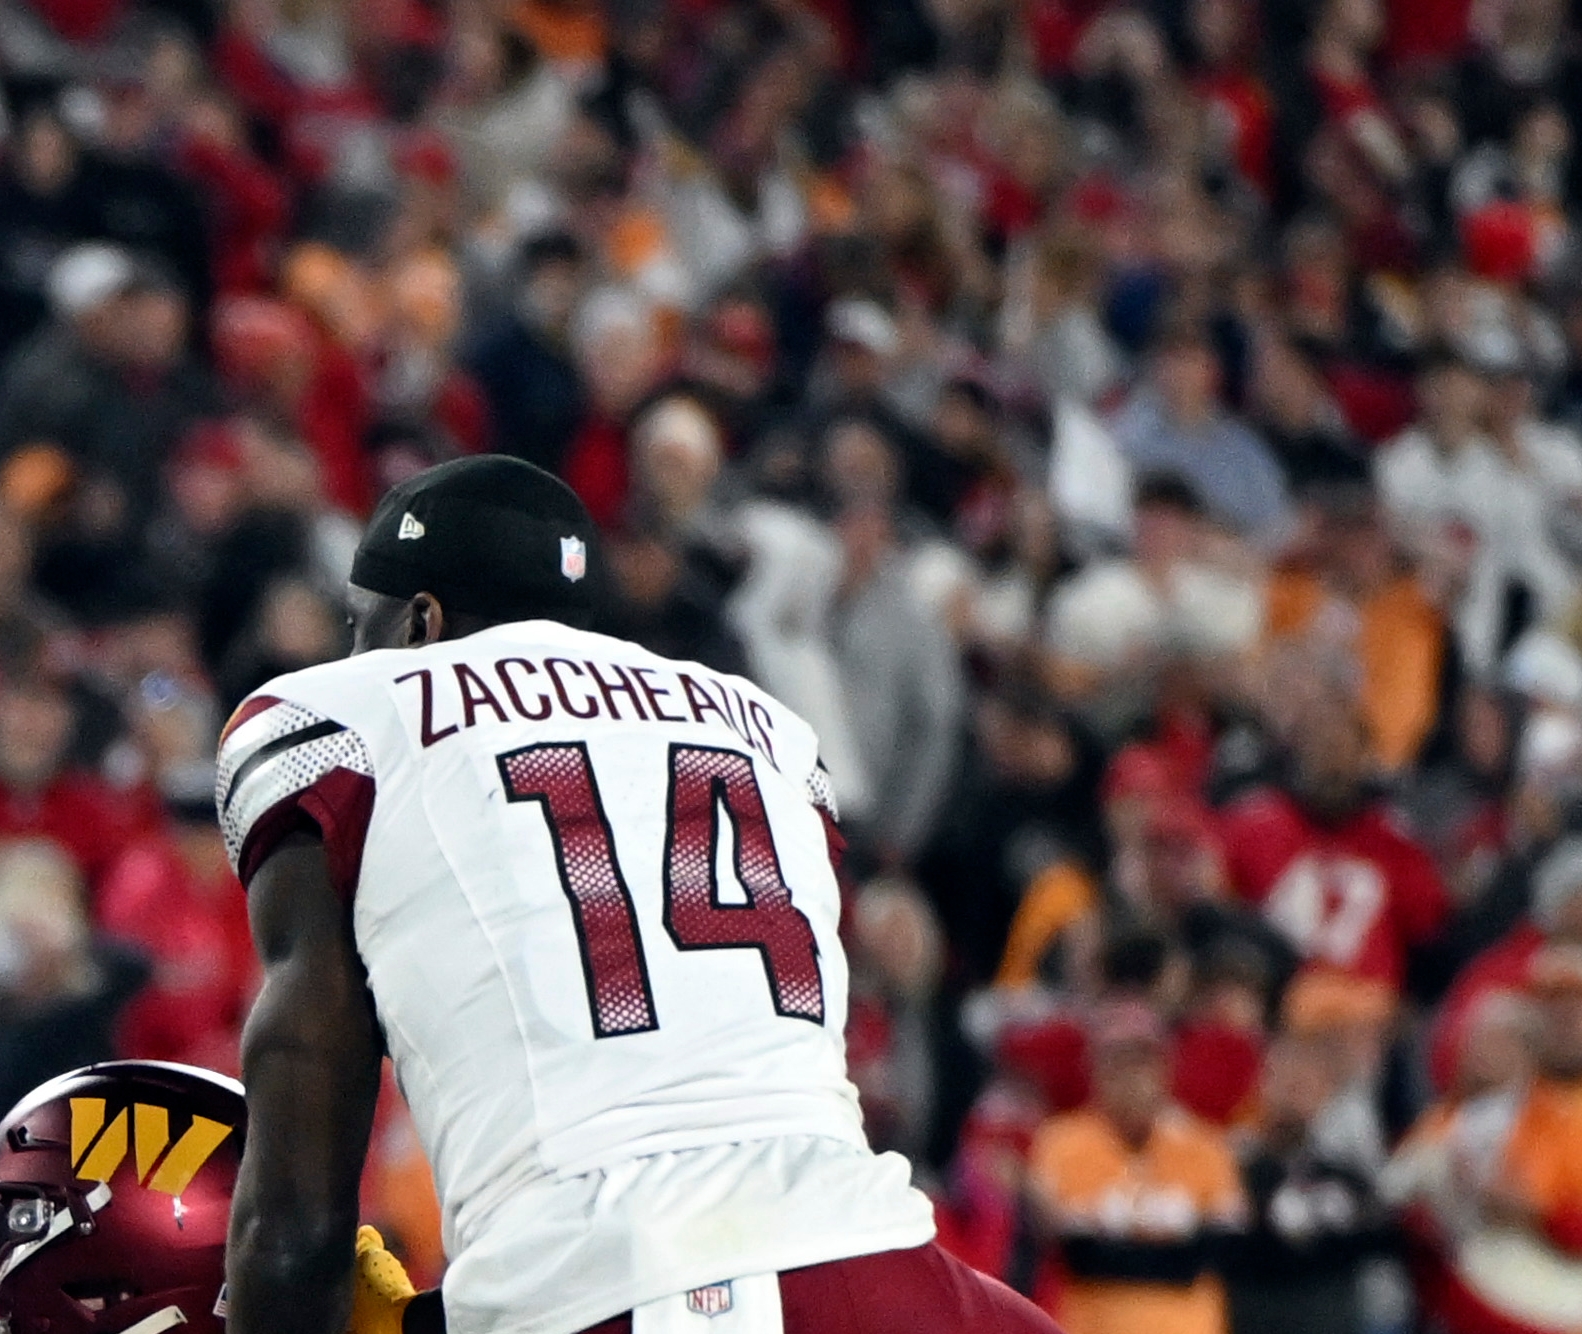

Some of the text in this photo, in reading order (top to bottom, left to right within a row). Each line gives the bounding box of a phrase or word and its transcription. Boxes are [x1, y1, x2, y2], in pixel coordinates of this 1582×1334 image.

[393, 656, 782, 775] ZACCHEAUS
[495, 740, 826, 1040] 14
[69, 1097, 234, 1197] W
[693, 1287, 729, 1312] NFL
